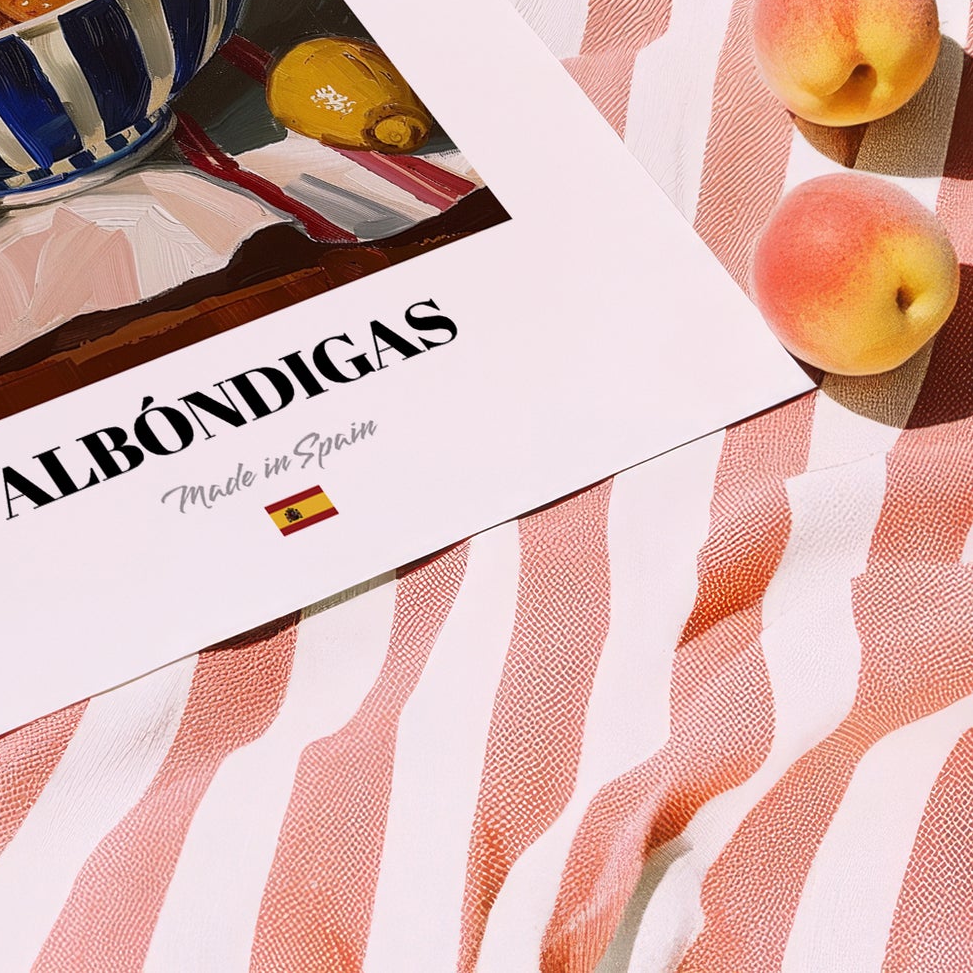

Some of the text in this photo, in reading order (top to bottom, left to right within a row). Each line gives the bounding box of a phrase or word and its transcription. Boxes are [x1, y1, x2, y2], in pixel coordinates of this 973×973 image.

[2, 298, 458, 520] ALBÓNDIGAS
[161, 420, 377, 514] Made in Spain
